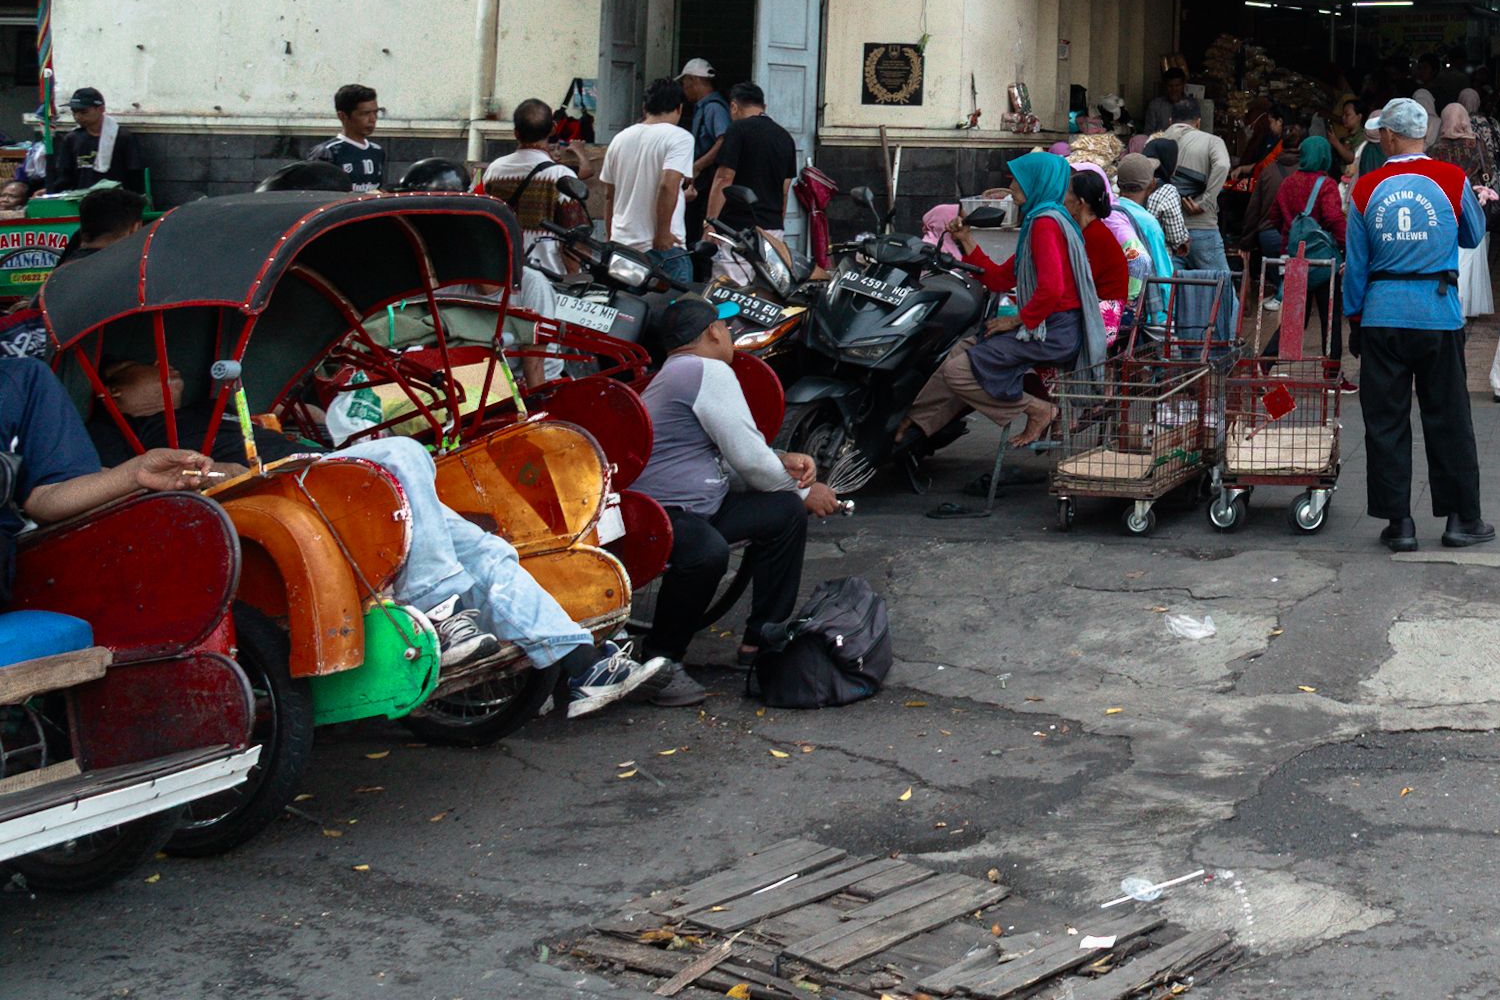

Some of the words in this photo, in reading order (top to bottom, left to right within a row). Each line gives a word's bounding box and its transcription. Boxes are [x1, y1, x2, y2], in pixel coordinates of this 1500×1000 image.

[362, 159, 375, 175] 10
[1375, 205, 1386, 229] SOLO
[1383, 190, 1414, 206] KUTHO
[1397, 206, 1411, 232] 6
[1396, 231, 1428, 241] KLEWER
[843, 270, 860, 281] AD
[860, 276, 888, 291] 4591
[713, 288, 730, 299] AD
[730, 293, 760, 309] 5739
[570, 299, 598, 314] 3534
[599, 308, 615, 321] MH
